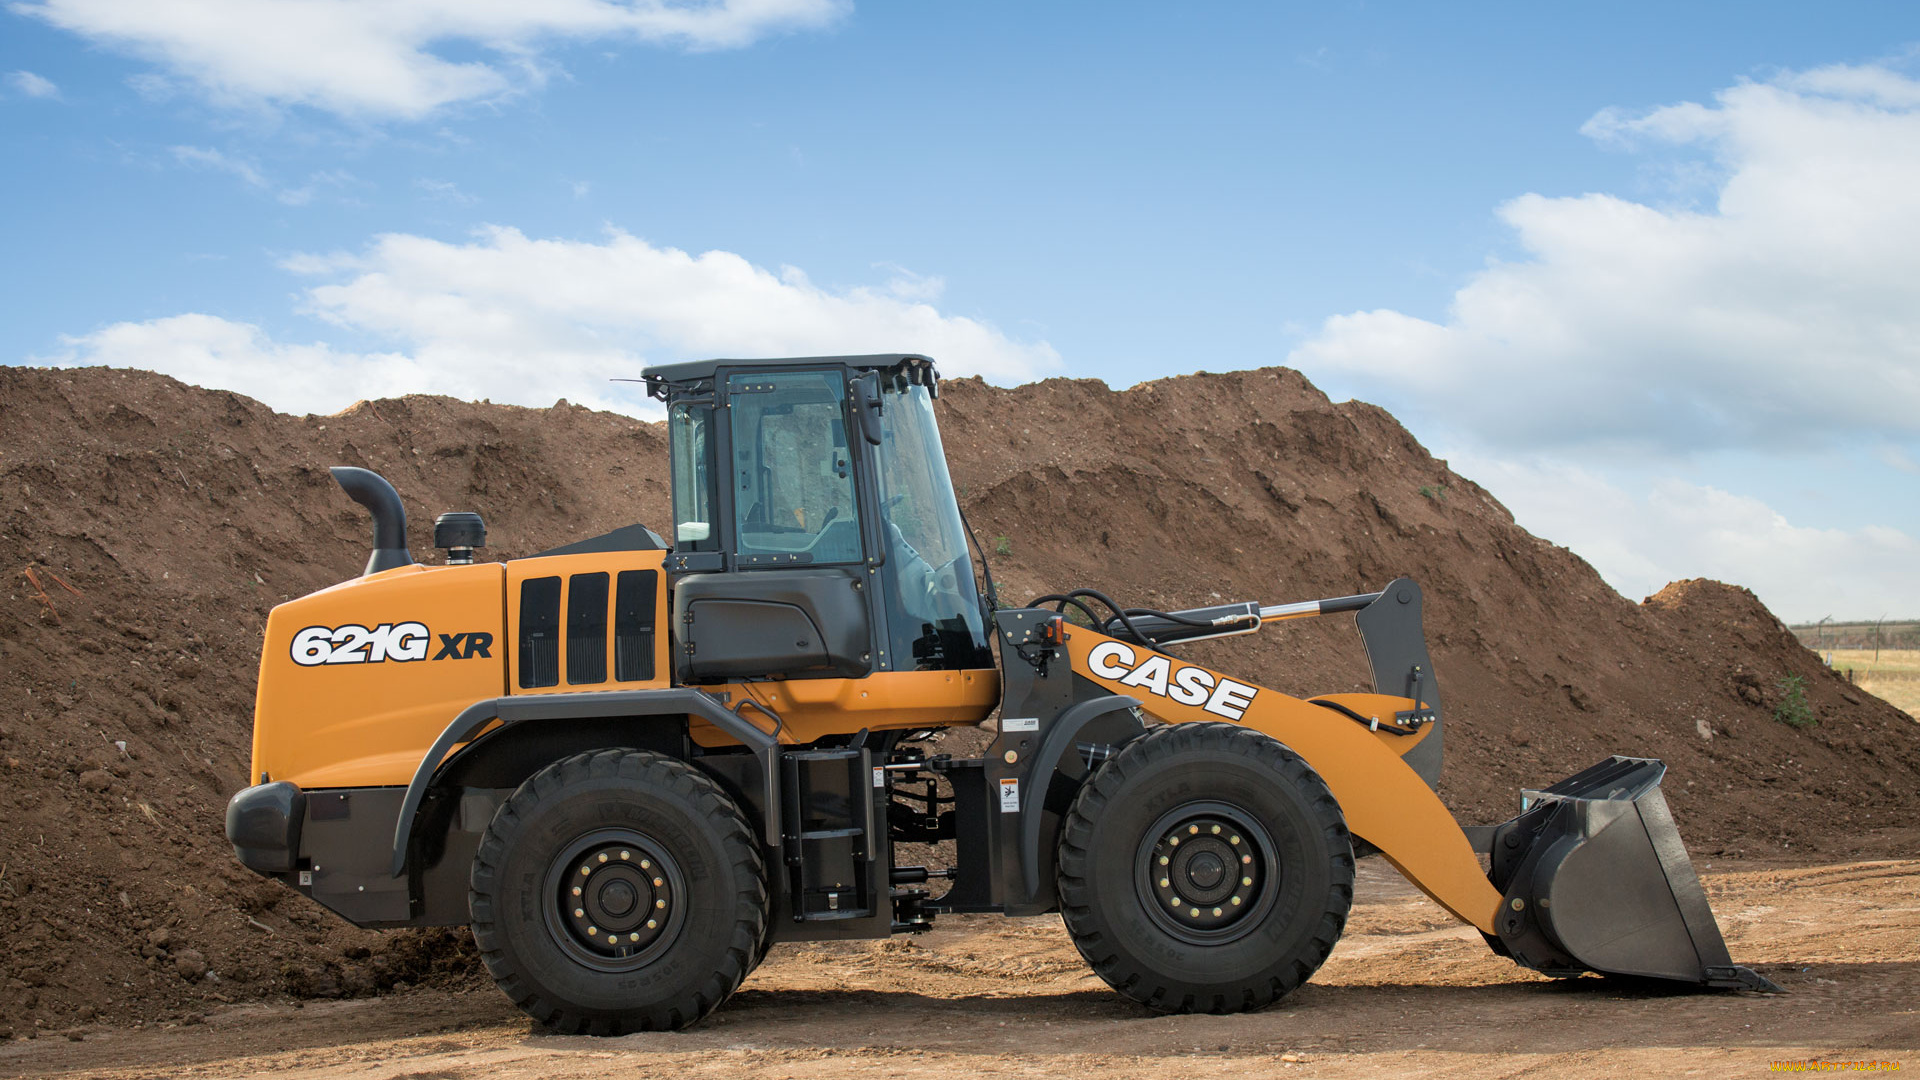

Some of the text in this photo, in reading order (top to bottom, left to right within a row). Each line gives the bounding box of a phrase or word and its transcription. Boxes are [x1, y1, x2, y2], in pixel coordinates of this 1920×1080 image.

[290, 621, 493, 667] 621G XR
[1087, 641, 1259, 721] CASE
